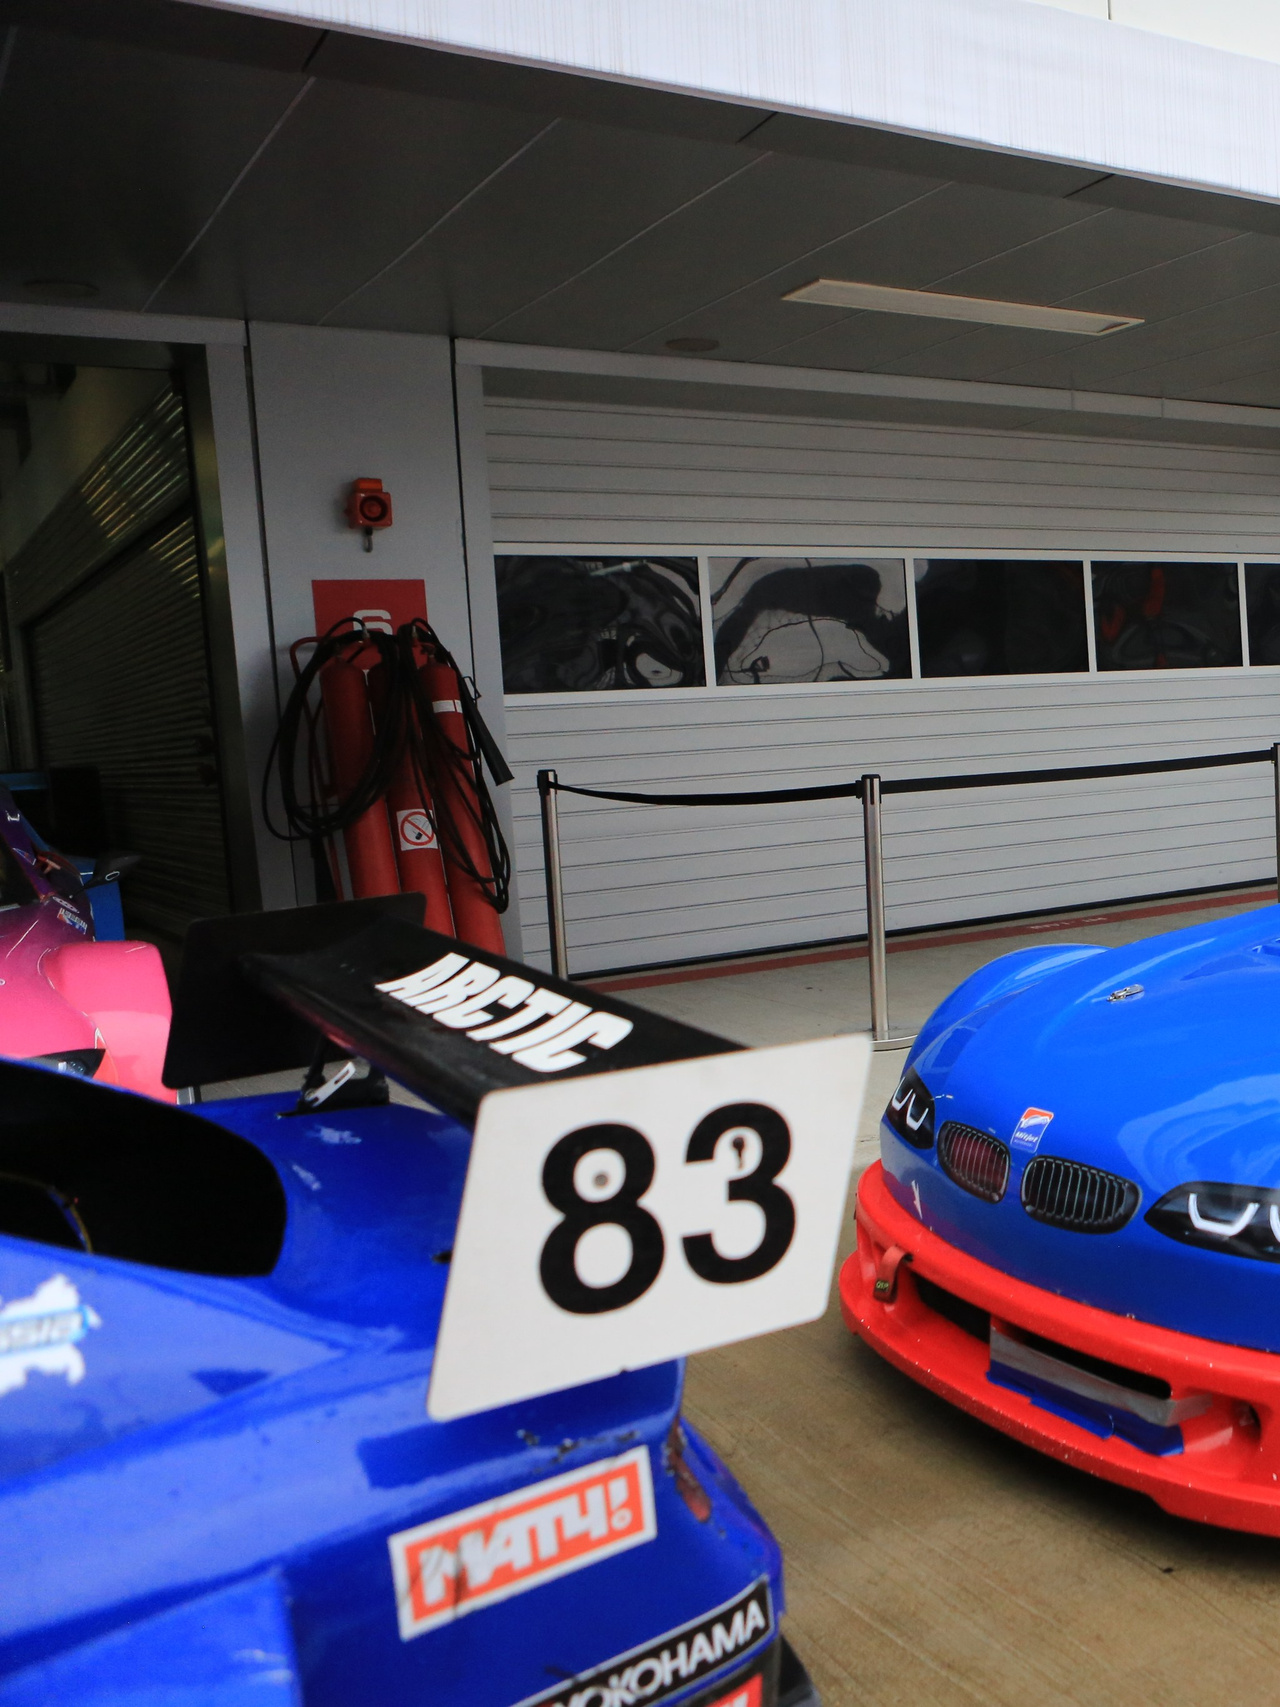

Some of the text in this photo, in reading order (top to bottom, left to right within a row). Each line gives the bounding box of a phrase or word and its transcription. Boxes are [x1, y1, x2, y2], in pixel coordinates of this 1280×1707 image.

[374, 952, 634, 1073] ARCTIC
[539, 1102, 796, 1315] 83
[553, 1599, 766, 1707] OKOHAMA
